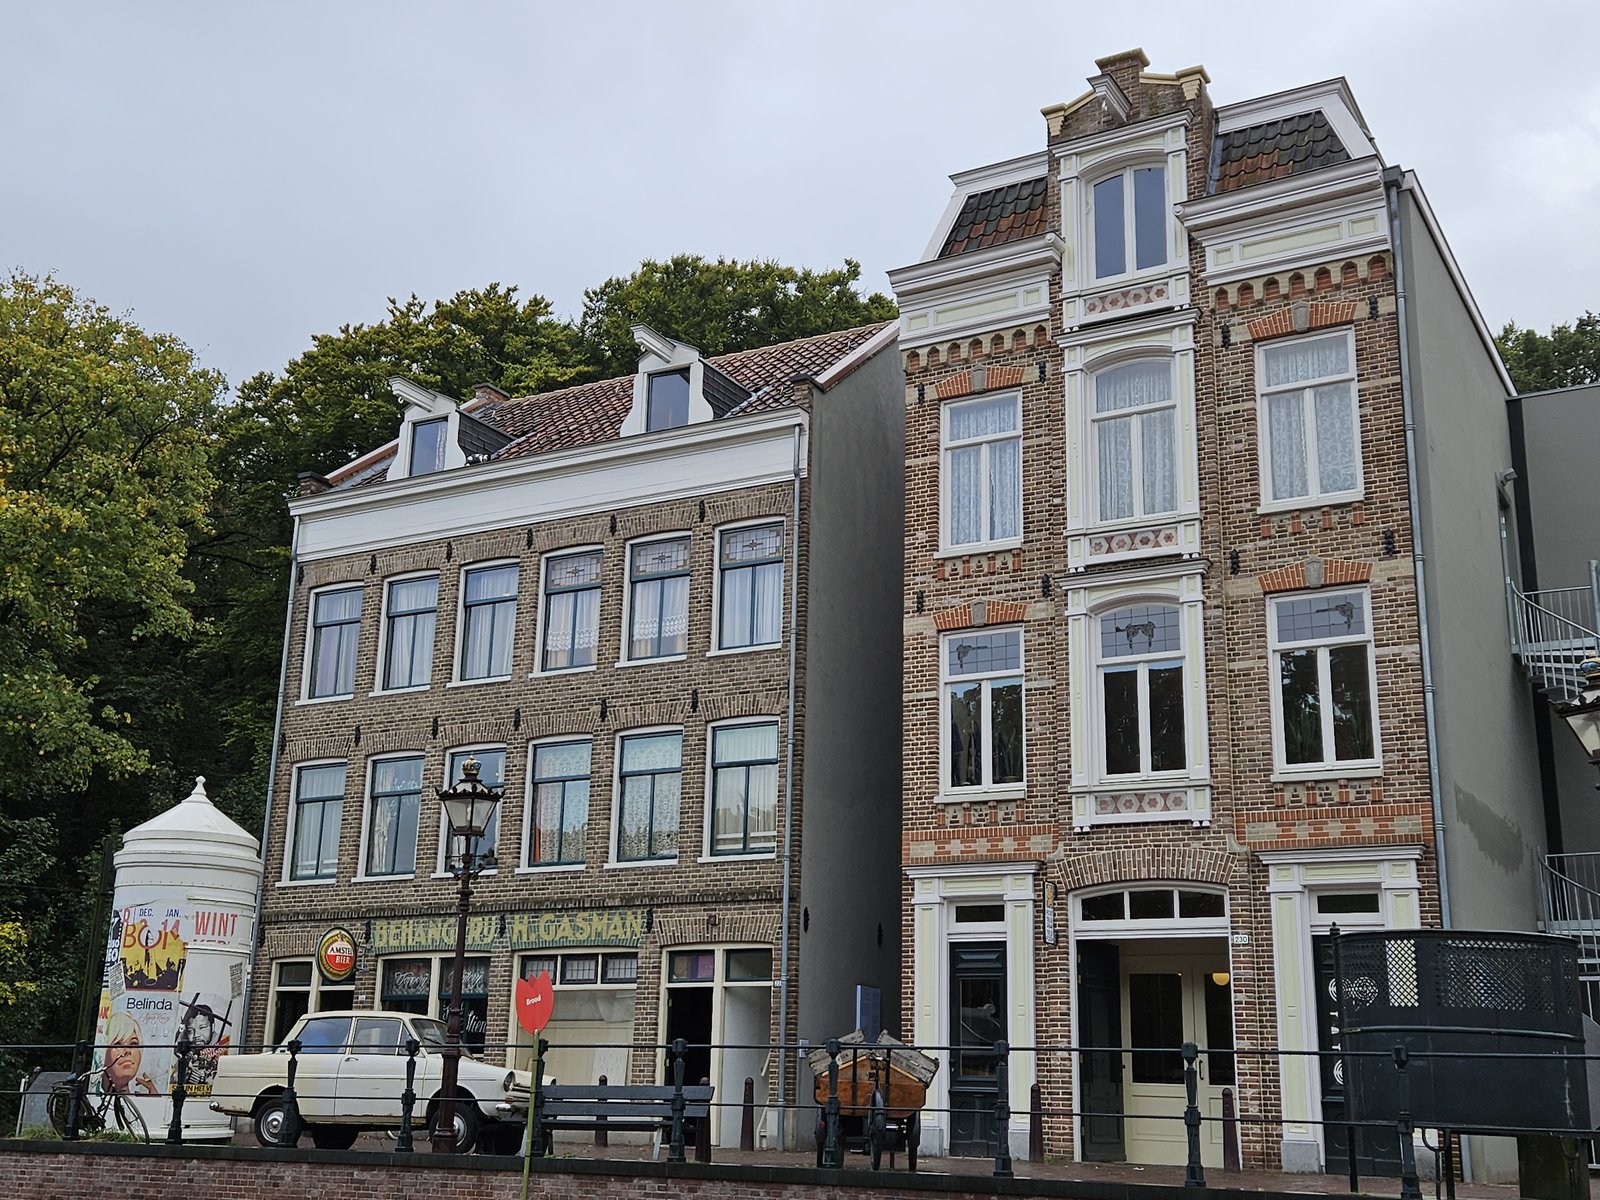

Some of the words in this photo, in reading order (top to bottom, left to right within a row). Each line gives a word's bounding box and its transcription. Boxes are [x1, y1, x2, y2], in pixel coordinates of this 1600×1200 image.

[166, 908, 182, 918] JAN.
[539, 911, 642, 942] GASMAN
[335, 955, 350, 964] BIER
[126, 997, 173, 1011] Belinda
